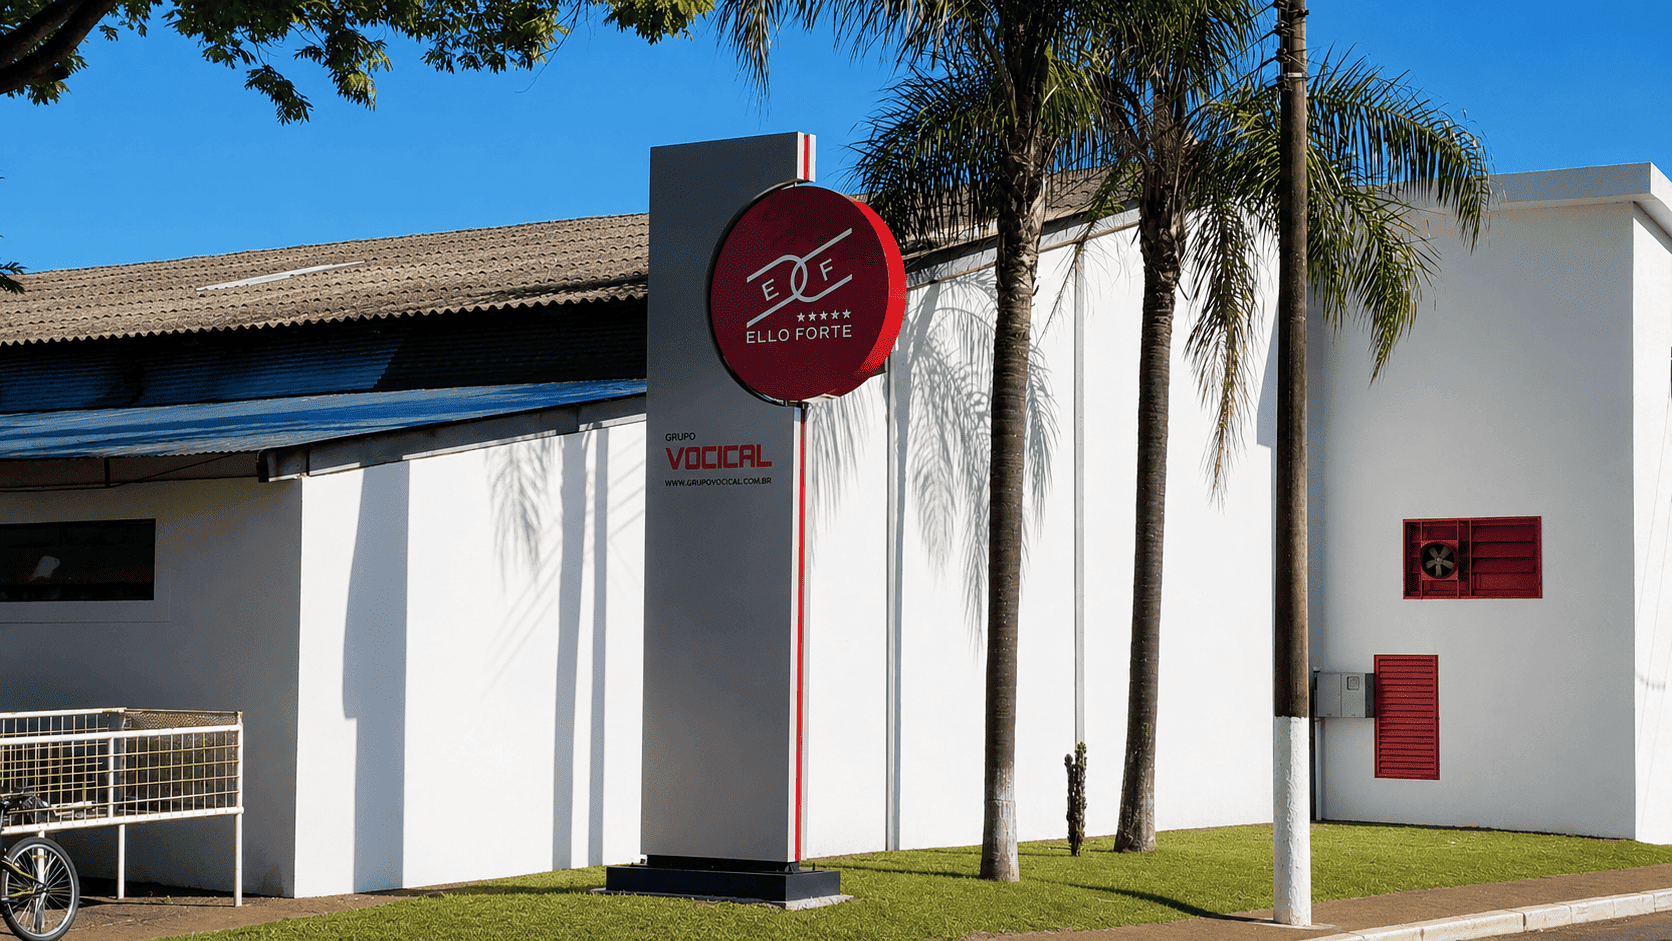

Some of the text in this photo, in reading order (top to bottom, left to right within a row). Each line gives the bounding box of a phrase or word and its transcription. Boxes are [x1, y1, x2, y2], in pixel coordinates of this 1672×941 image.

[761, 258, 834, 301] E F
[746, 324, 852, 344] ELLO FORTE
[665, 432, 696, 442] GRUPO
[665, 444, 773, 470] VOCICAL
[664, 477, 772, 487] WWW.GRUPOVOCICAL.COM.BR
